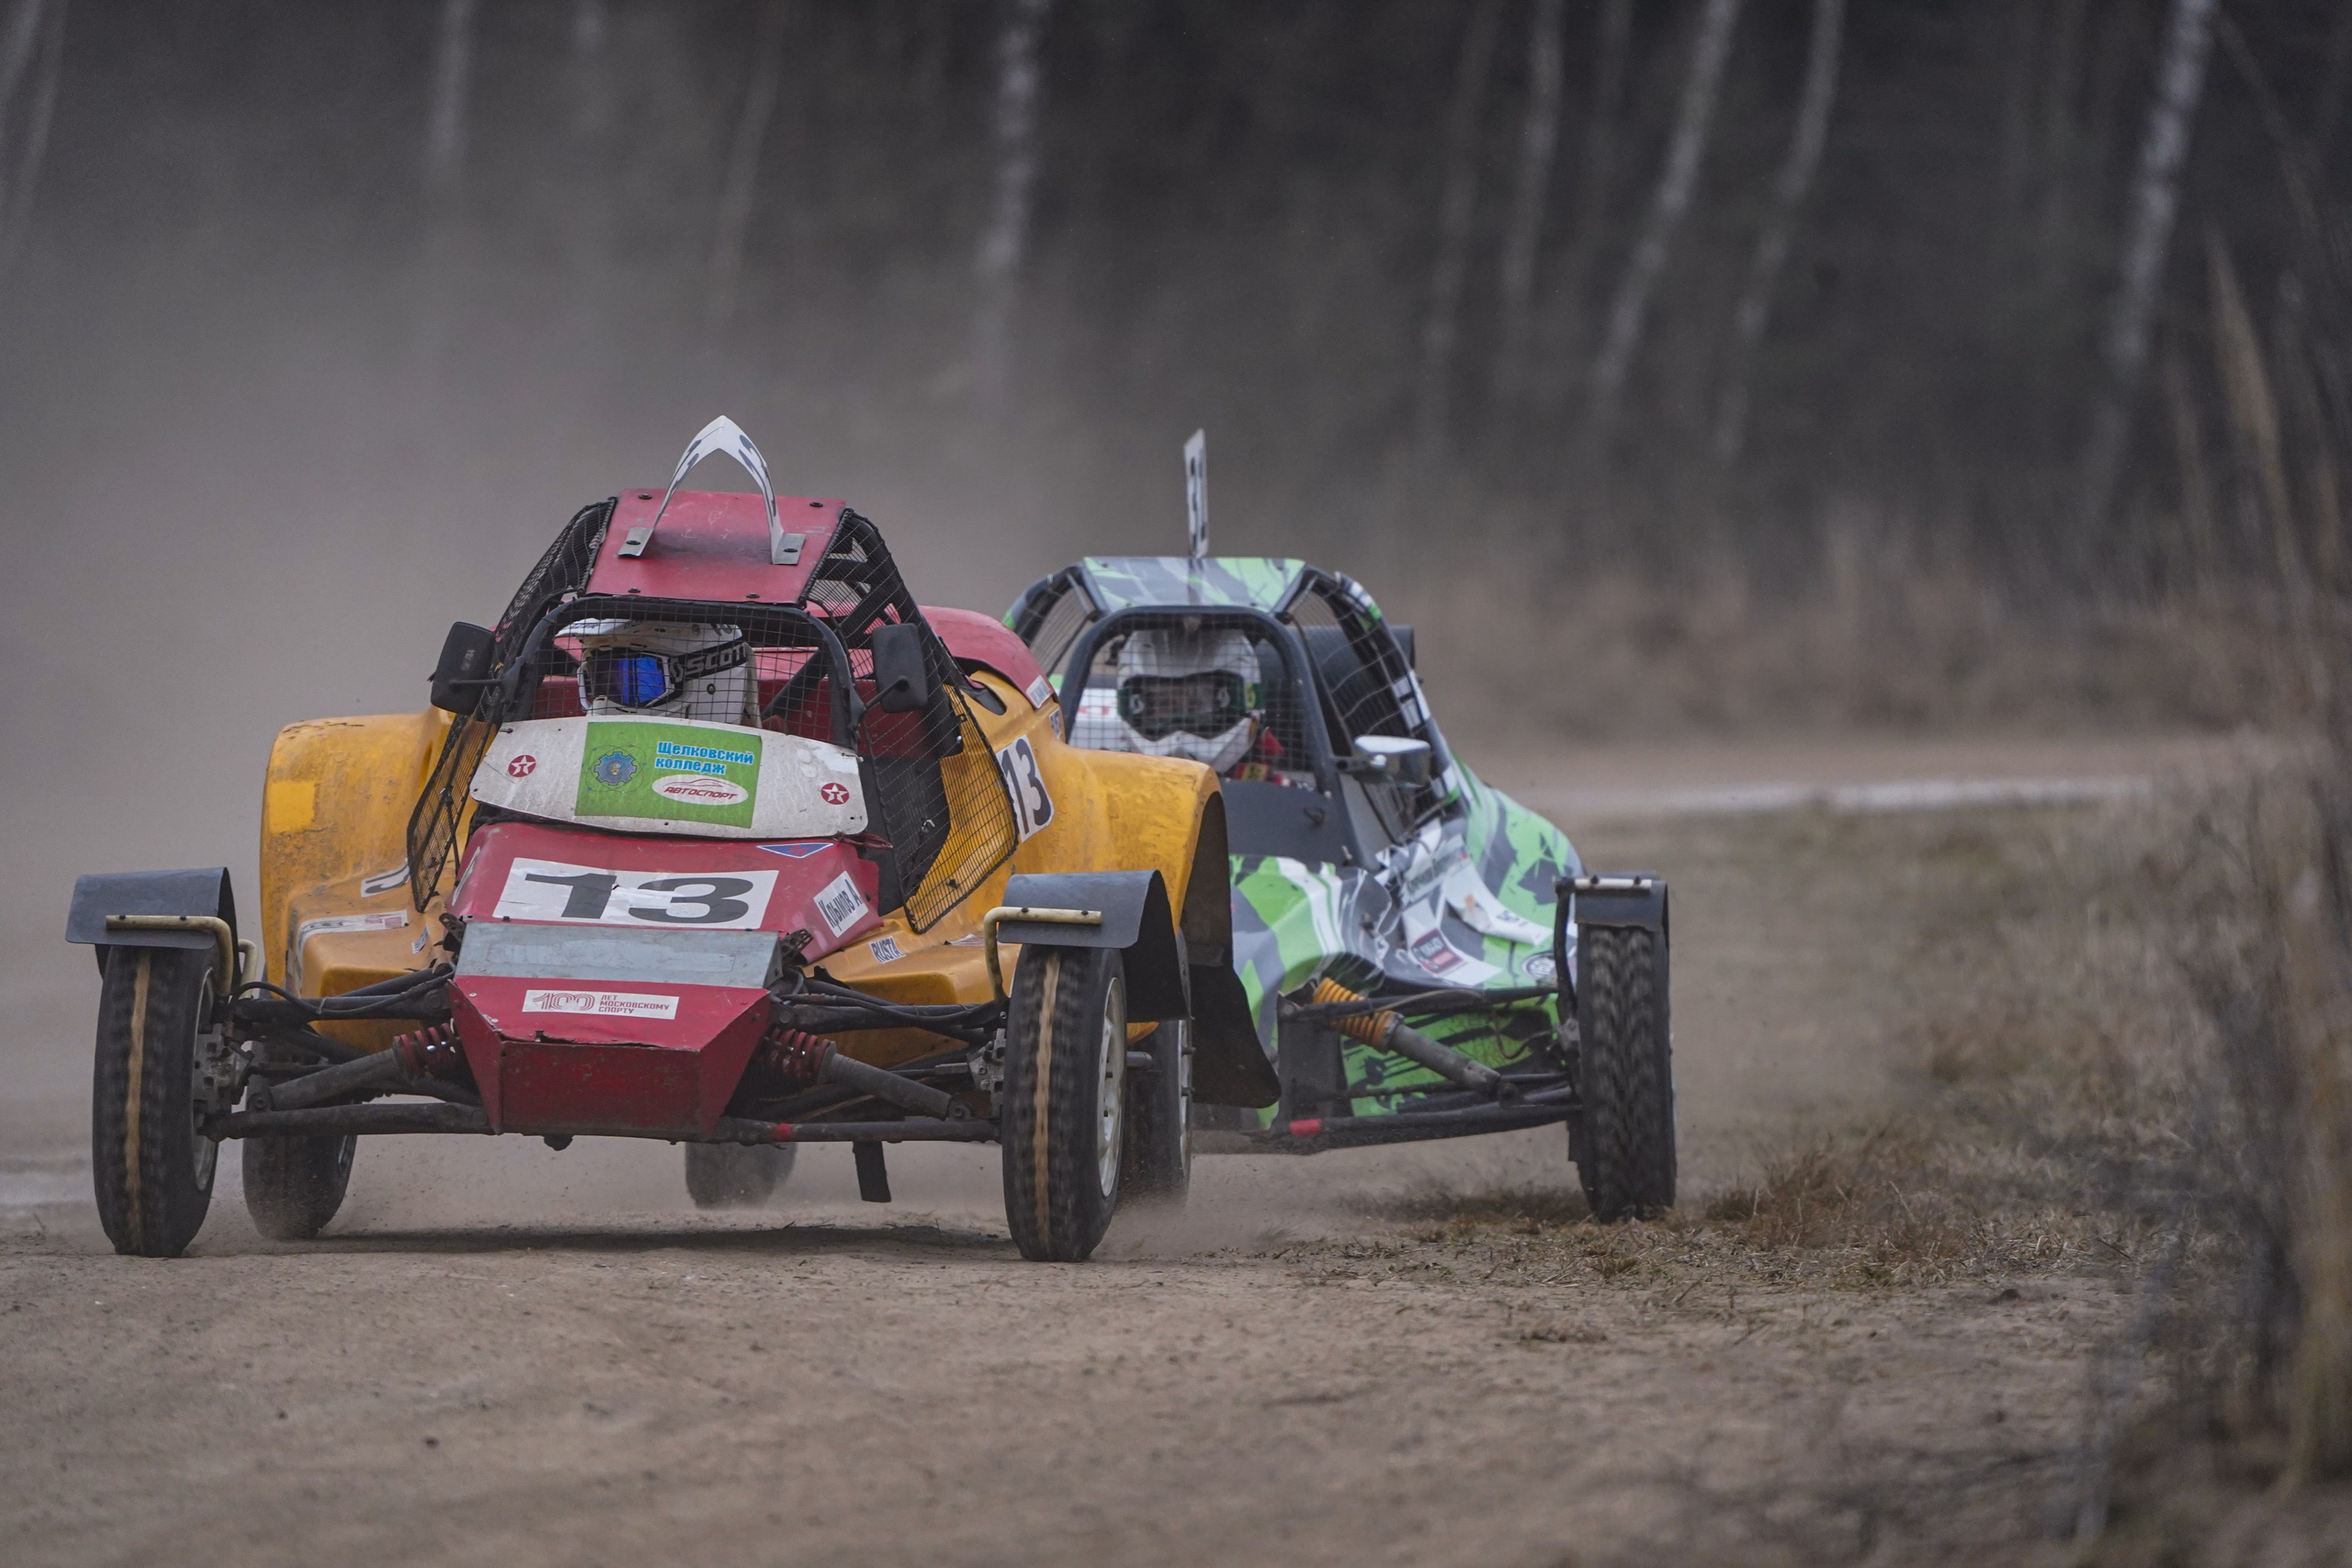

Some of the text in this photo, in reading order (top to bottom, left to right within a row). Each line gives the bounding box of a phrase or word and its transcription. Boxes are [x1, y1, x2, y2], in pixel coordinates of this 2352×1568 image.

[657, 741, 754, 764] Щелковский
[655, 757, 726, 774] колледж
[663, 786, 739, 800] АВТОСПОРТ
[1001, 738, 1052, 835] 13
[525, 872, 753, 924] 13
[818, 890, 855, 931] Крымов
[532, 992, 595, 1010] 100
[599, 1000, 670, 1010] МОСКОВСКОМУ
